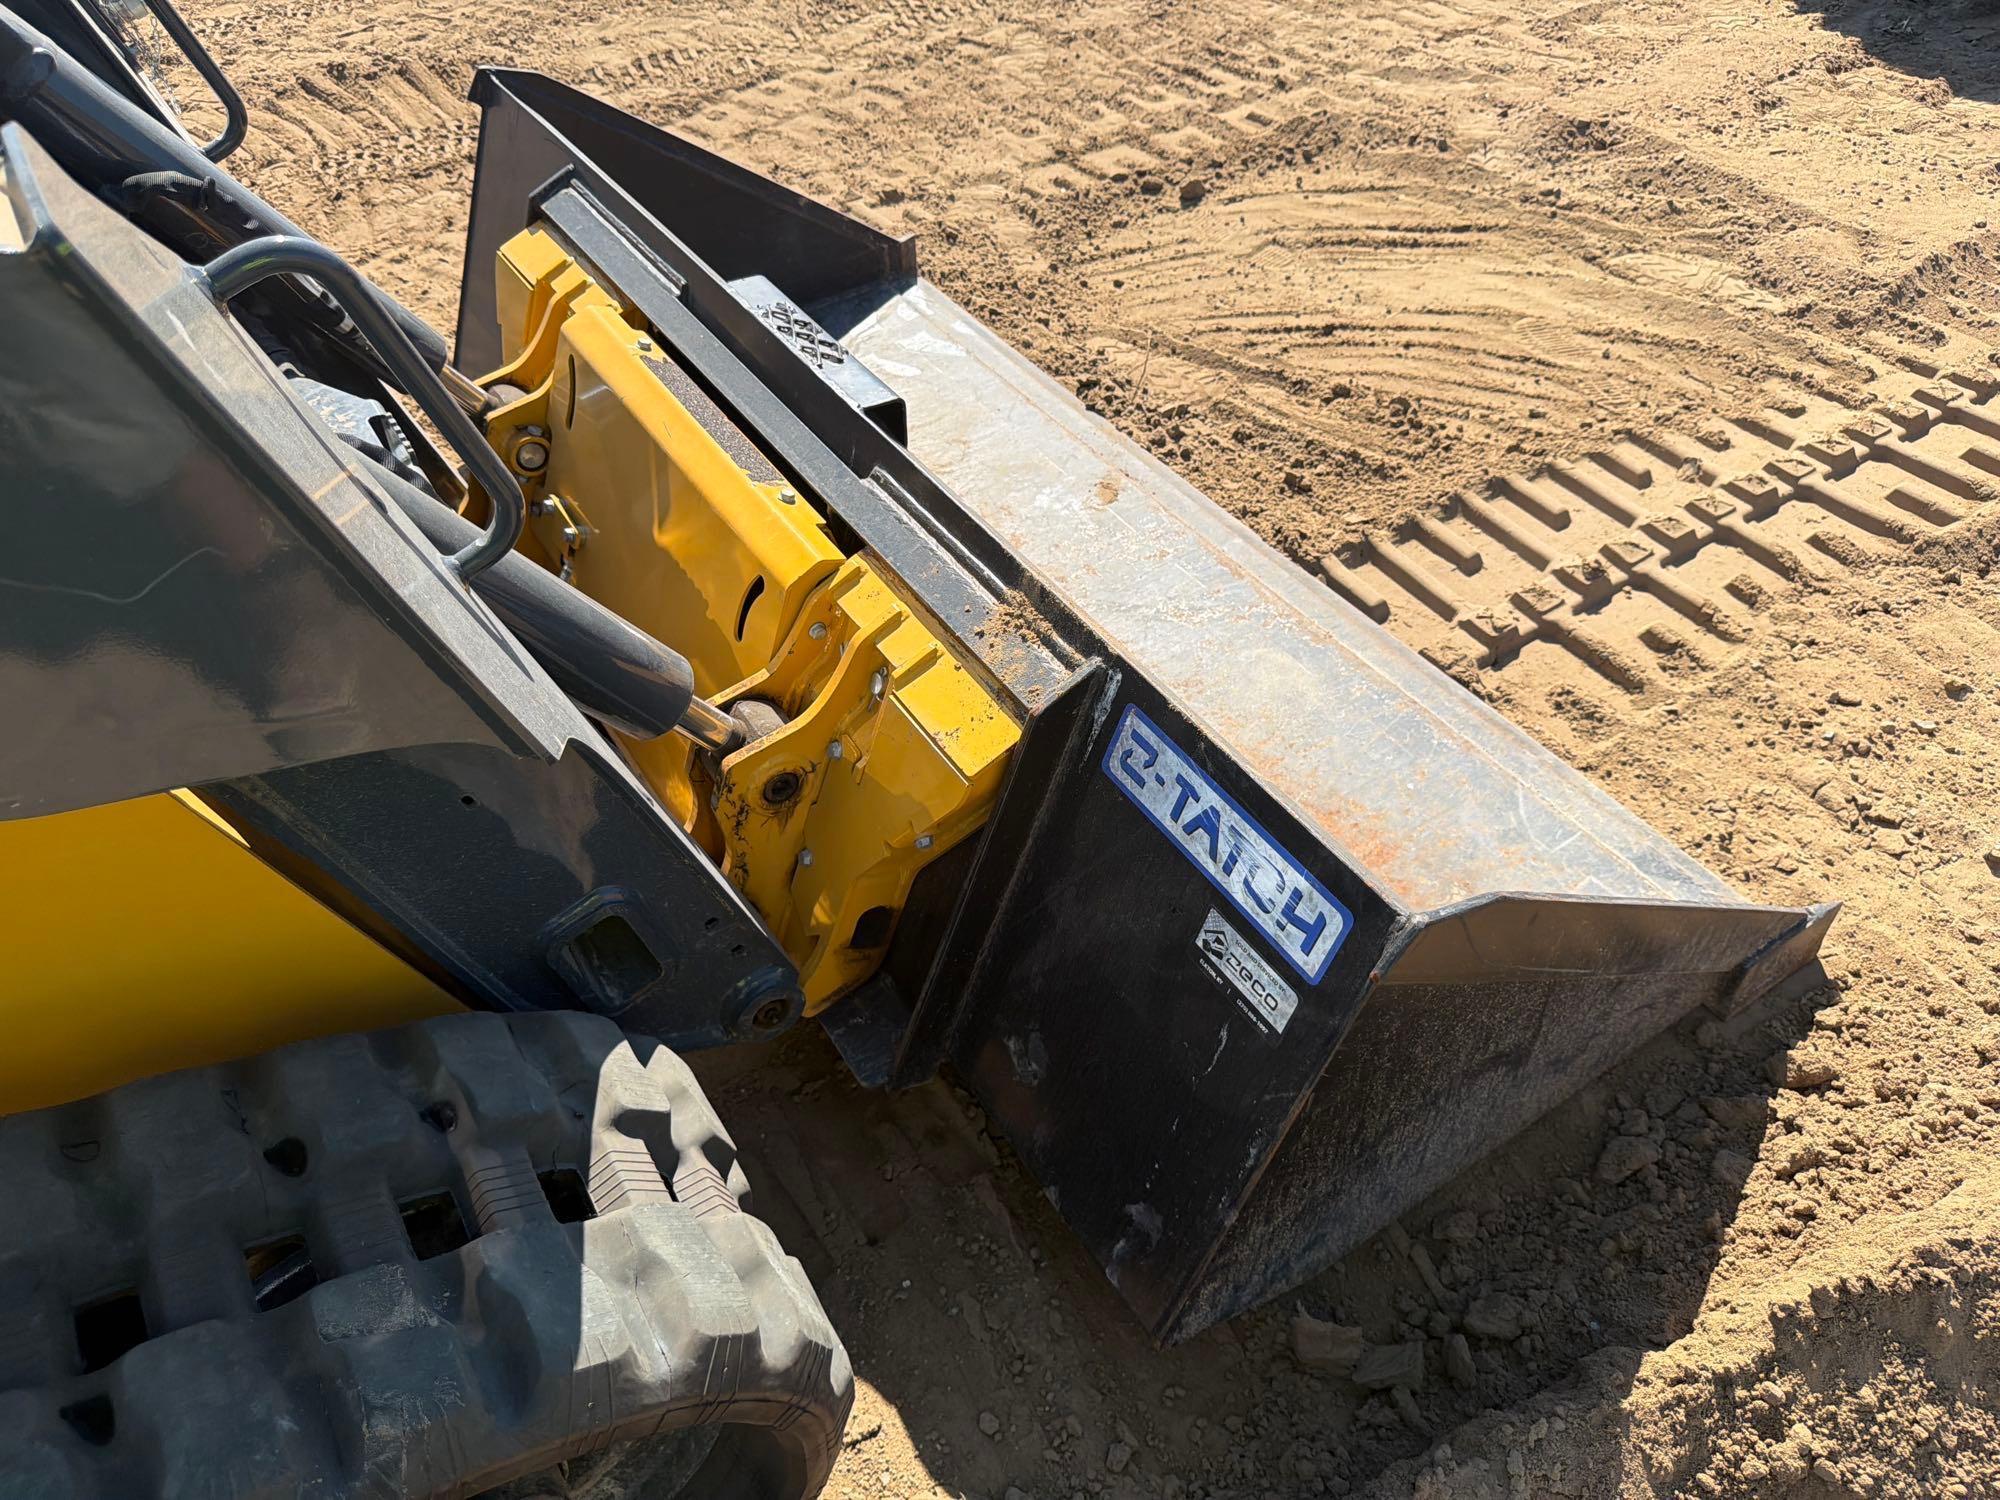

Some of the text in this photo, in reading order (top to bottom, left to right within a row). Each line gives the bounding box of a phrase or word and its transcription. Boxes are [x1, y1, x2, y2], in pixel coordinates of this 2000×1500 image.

[1235, 939, 1248, 954] SOLD
[1247, 952, 1258, 964] AND
[1256, 961, 1279, 986] SERVICED
